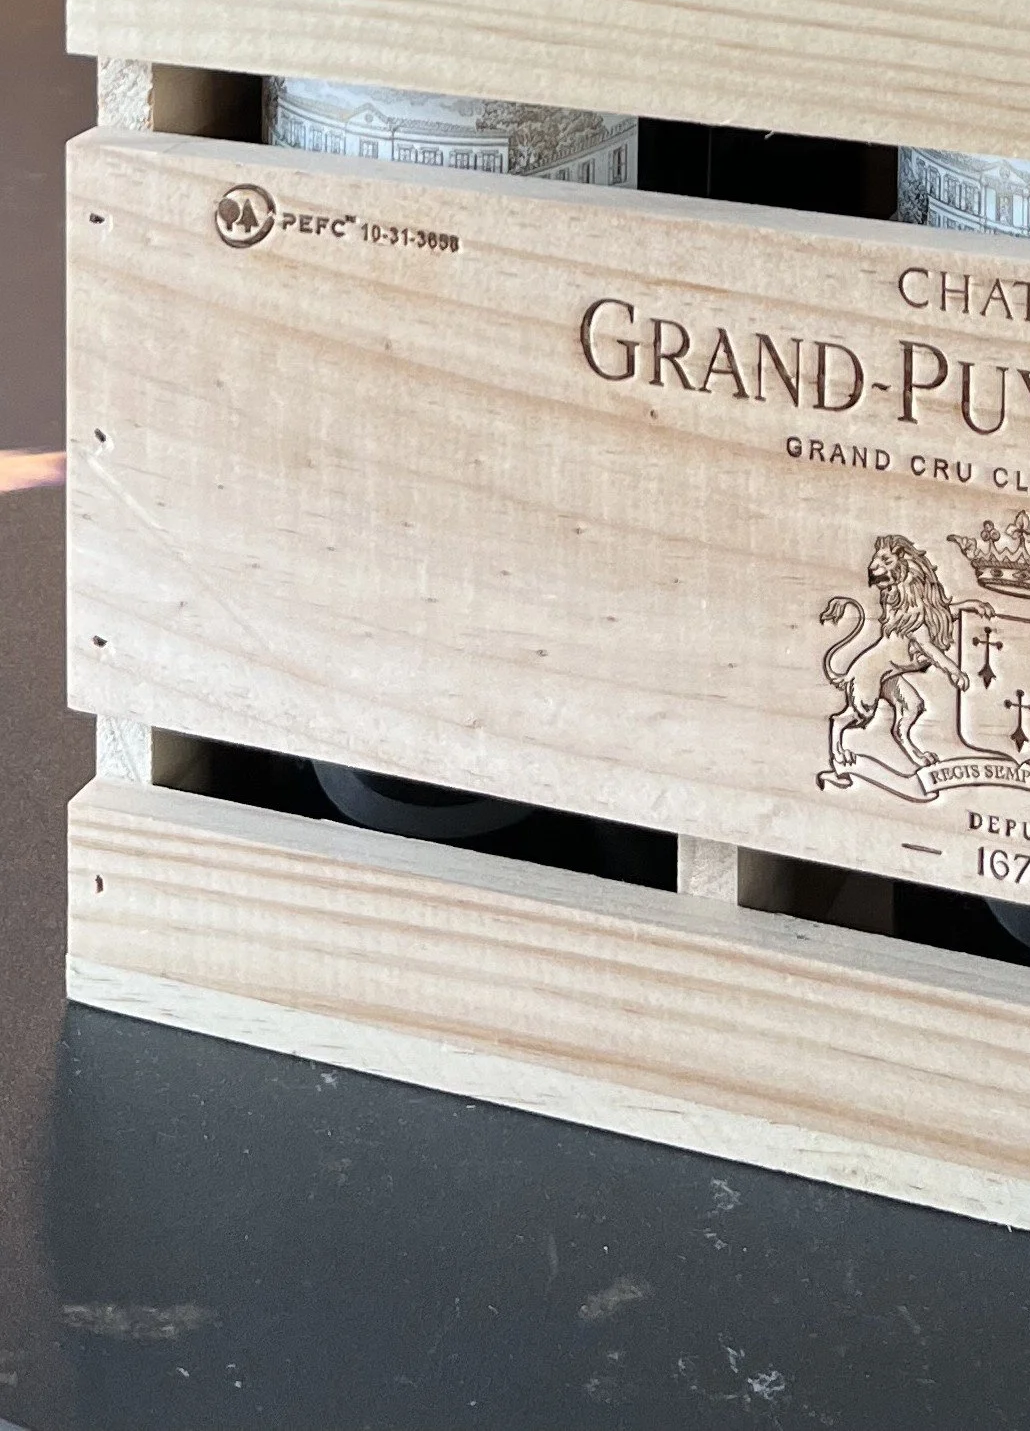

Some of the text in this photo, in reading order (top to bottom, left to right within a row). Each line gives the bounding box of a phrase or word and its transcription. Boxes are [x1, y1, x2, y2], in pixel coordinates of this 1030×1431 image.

[785, 436, 892, 472] GRAND
[909, 454, 974, 484] CRU
[930, 764, 981, 784] REGIS
